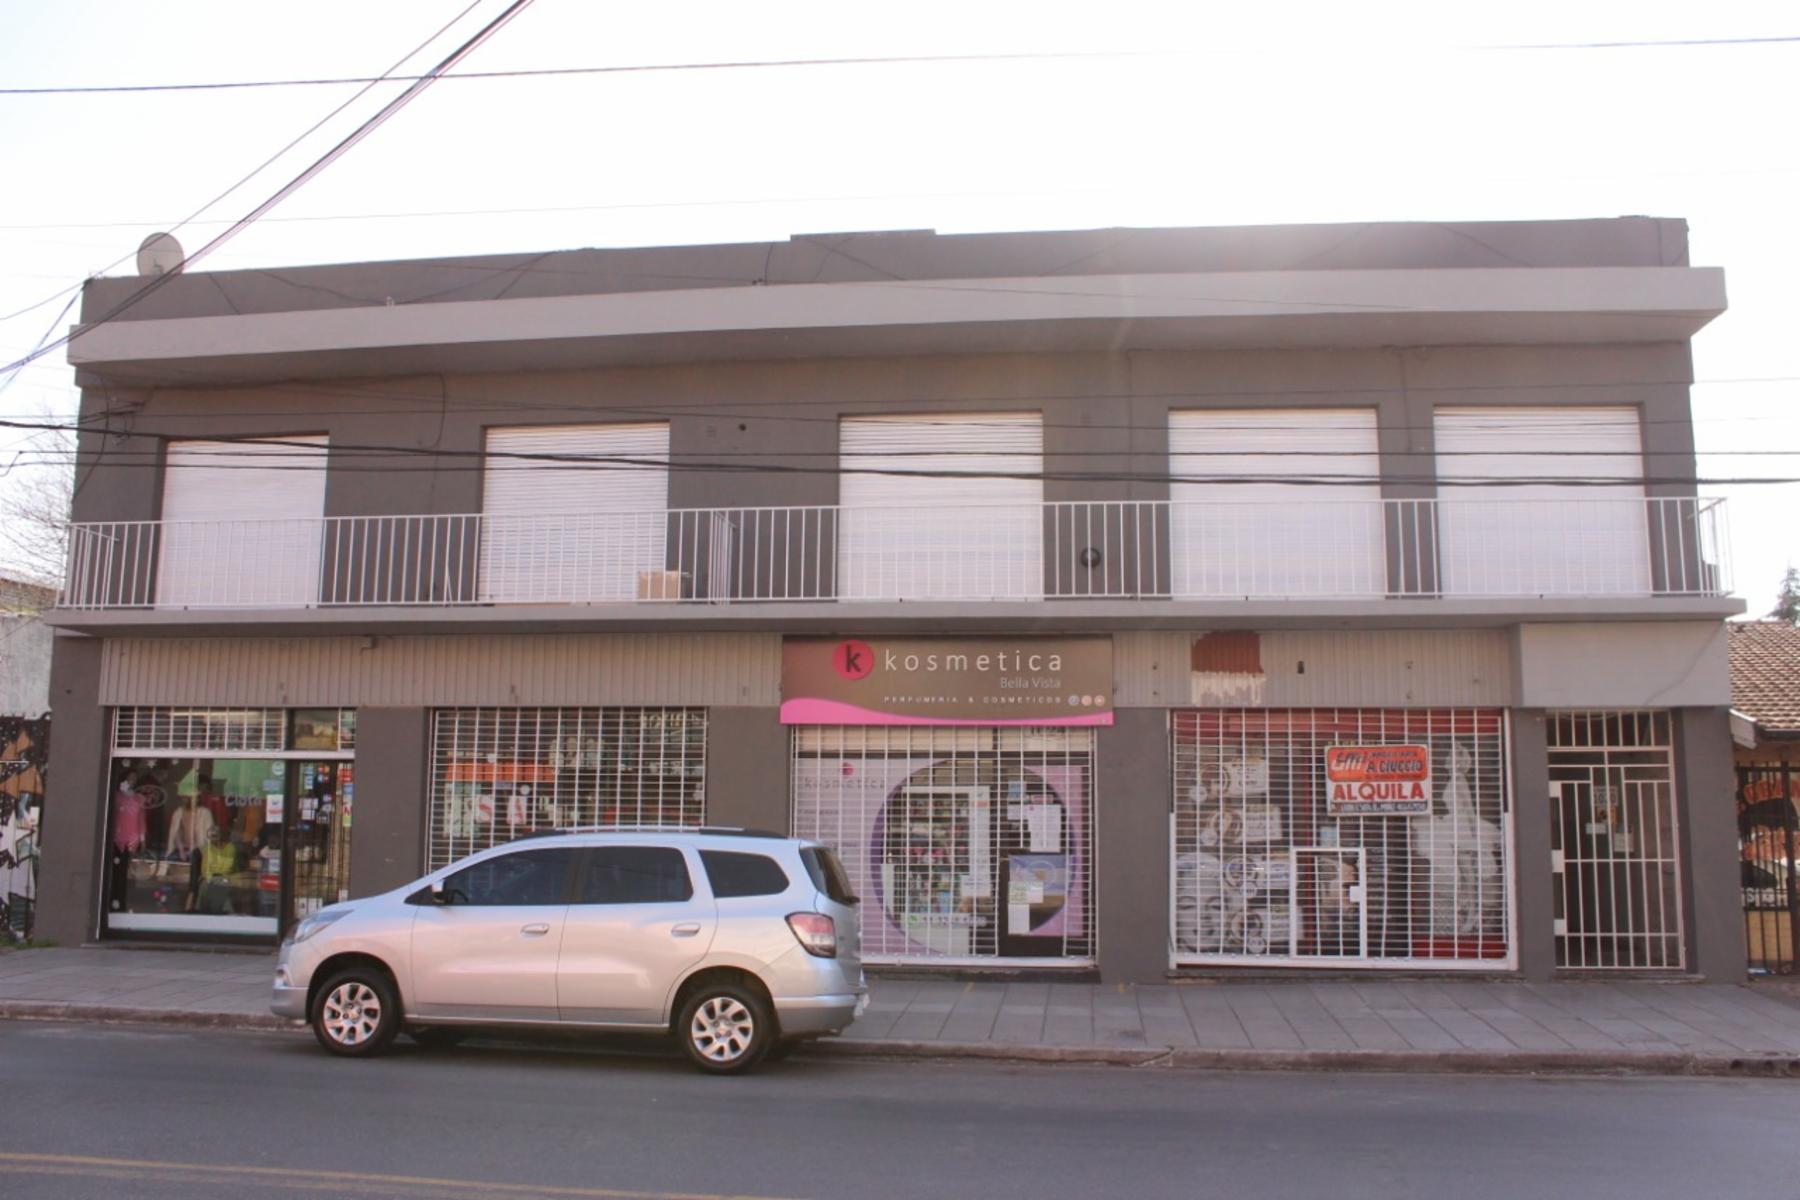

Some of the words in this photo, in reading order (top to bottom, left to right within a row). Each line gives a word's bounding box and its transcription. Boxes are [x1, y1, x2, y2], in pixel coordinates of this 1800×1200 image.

[846, 645, 861, 673] k
[885, 648, 1063, 672] kosmetica
[999, 676, 1029, 689] Bella
[1031, 676, 1062, 689] Vista
[1333, 781, 1425, 801] ALQUILA
